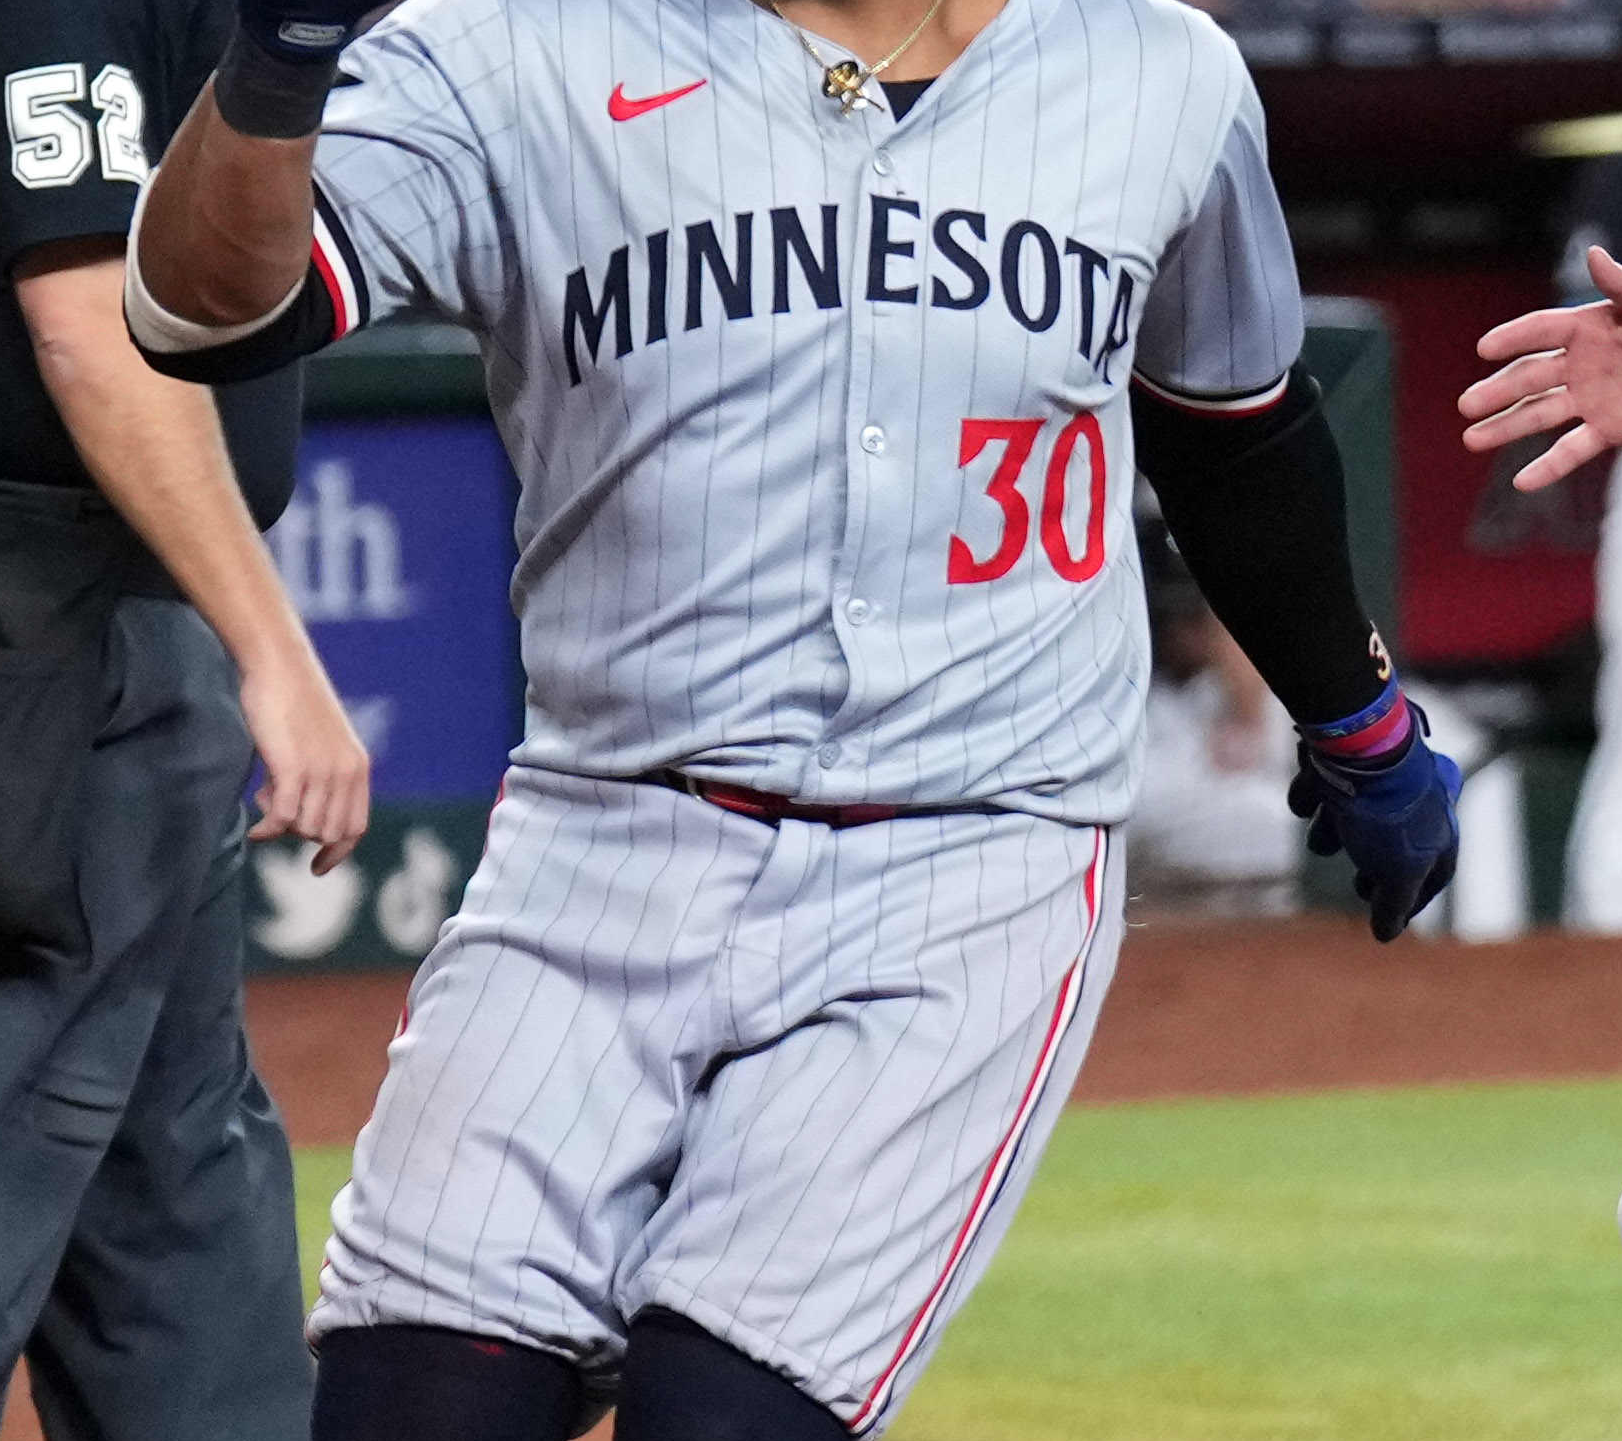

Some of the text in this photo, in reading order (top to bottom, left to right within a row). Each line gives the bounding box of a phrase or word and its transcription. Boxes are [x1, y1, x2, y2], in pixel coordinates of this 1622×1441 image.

[4, 62, 151, 190] 52
[562, 193, 1135, 386] MINNESOTA
[947, 411, 1106, 585] 30
